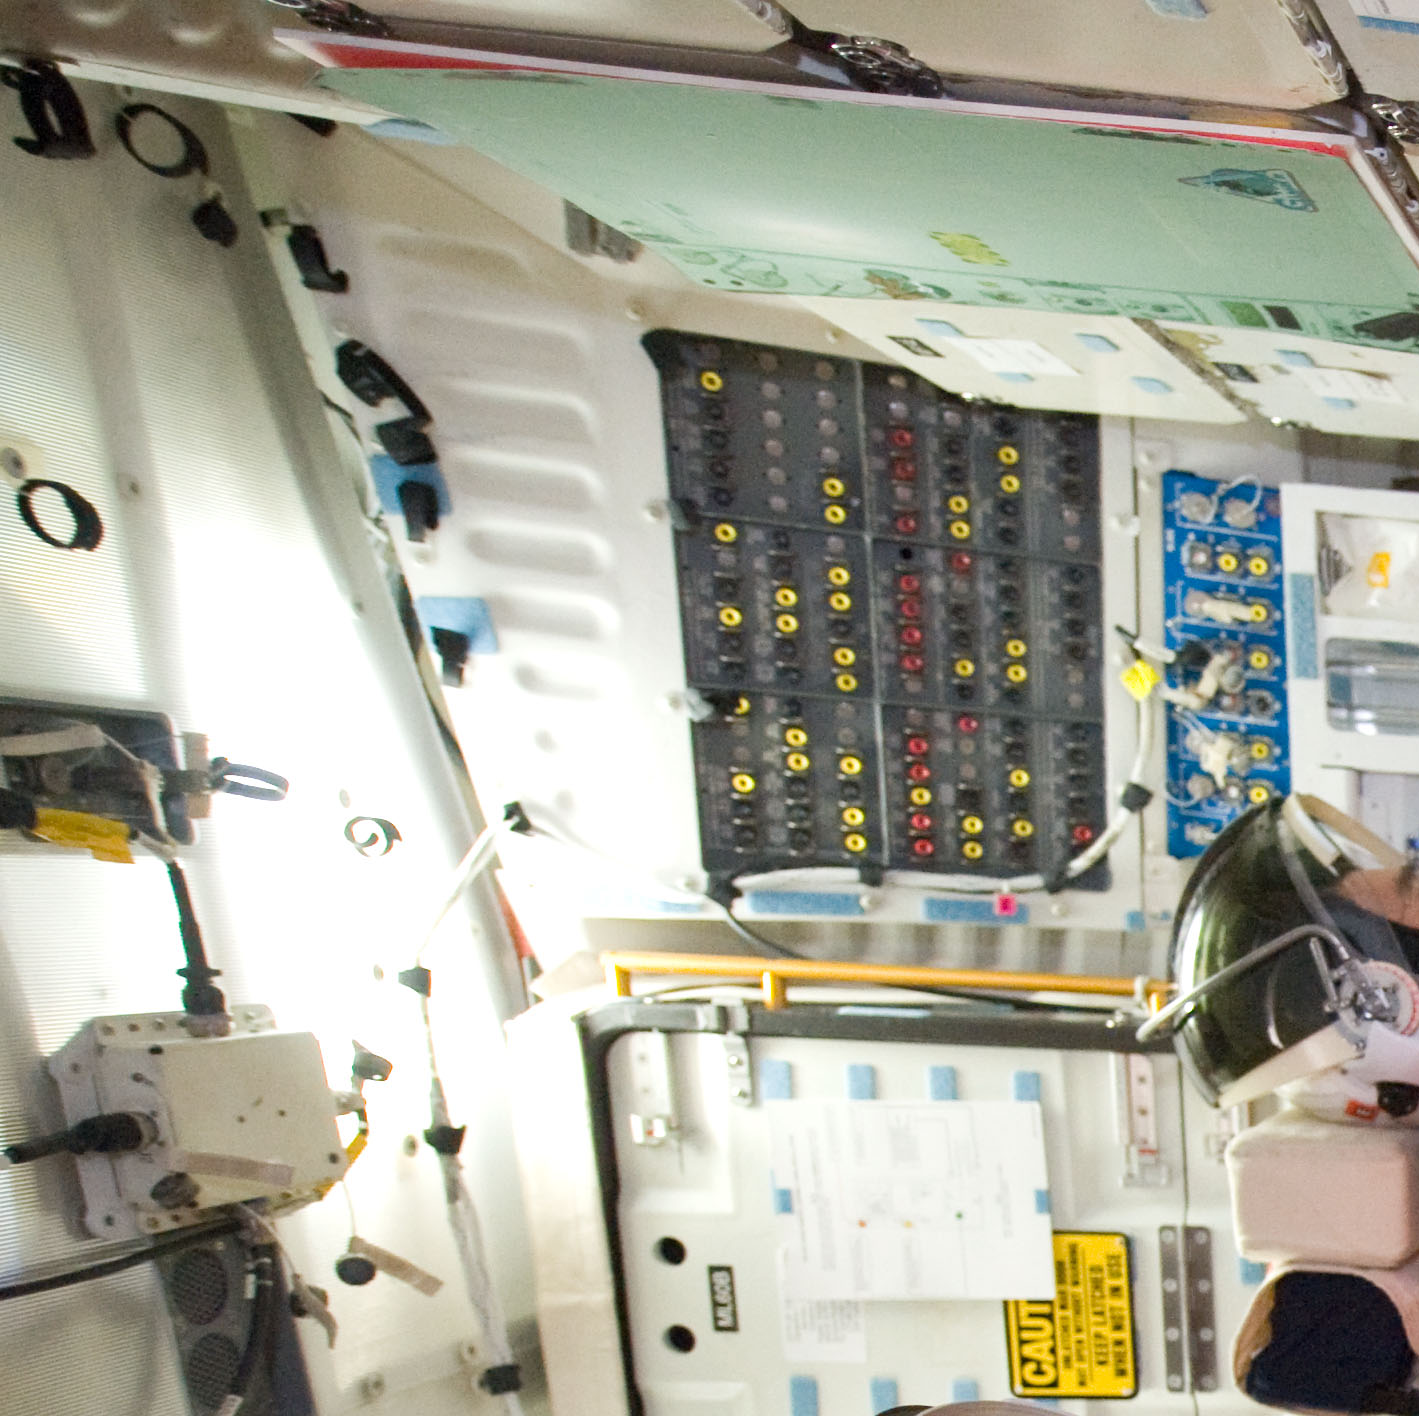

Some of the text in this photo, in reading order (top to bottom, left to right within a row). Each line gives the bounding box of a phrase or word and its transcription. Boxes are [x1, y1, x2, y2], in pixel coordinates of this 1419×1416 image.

[1018, 1298, 1058, 1387] CAUT
[1088, 1264, 1109, 1366] KEEP LATCHED
[1105, 1253, 1128, 1378] WHEN NOT IN USE
